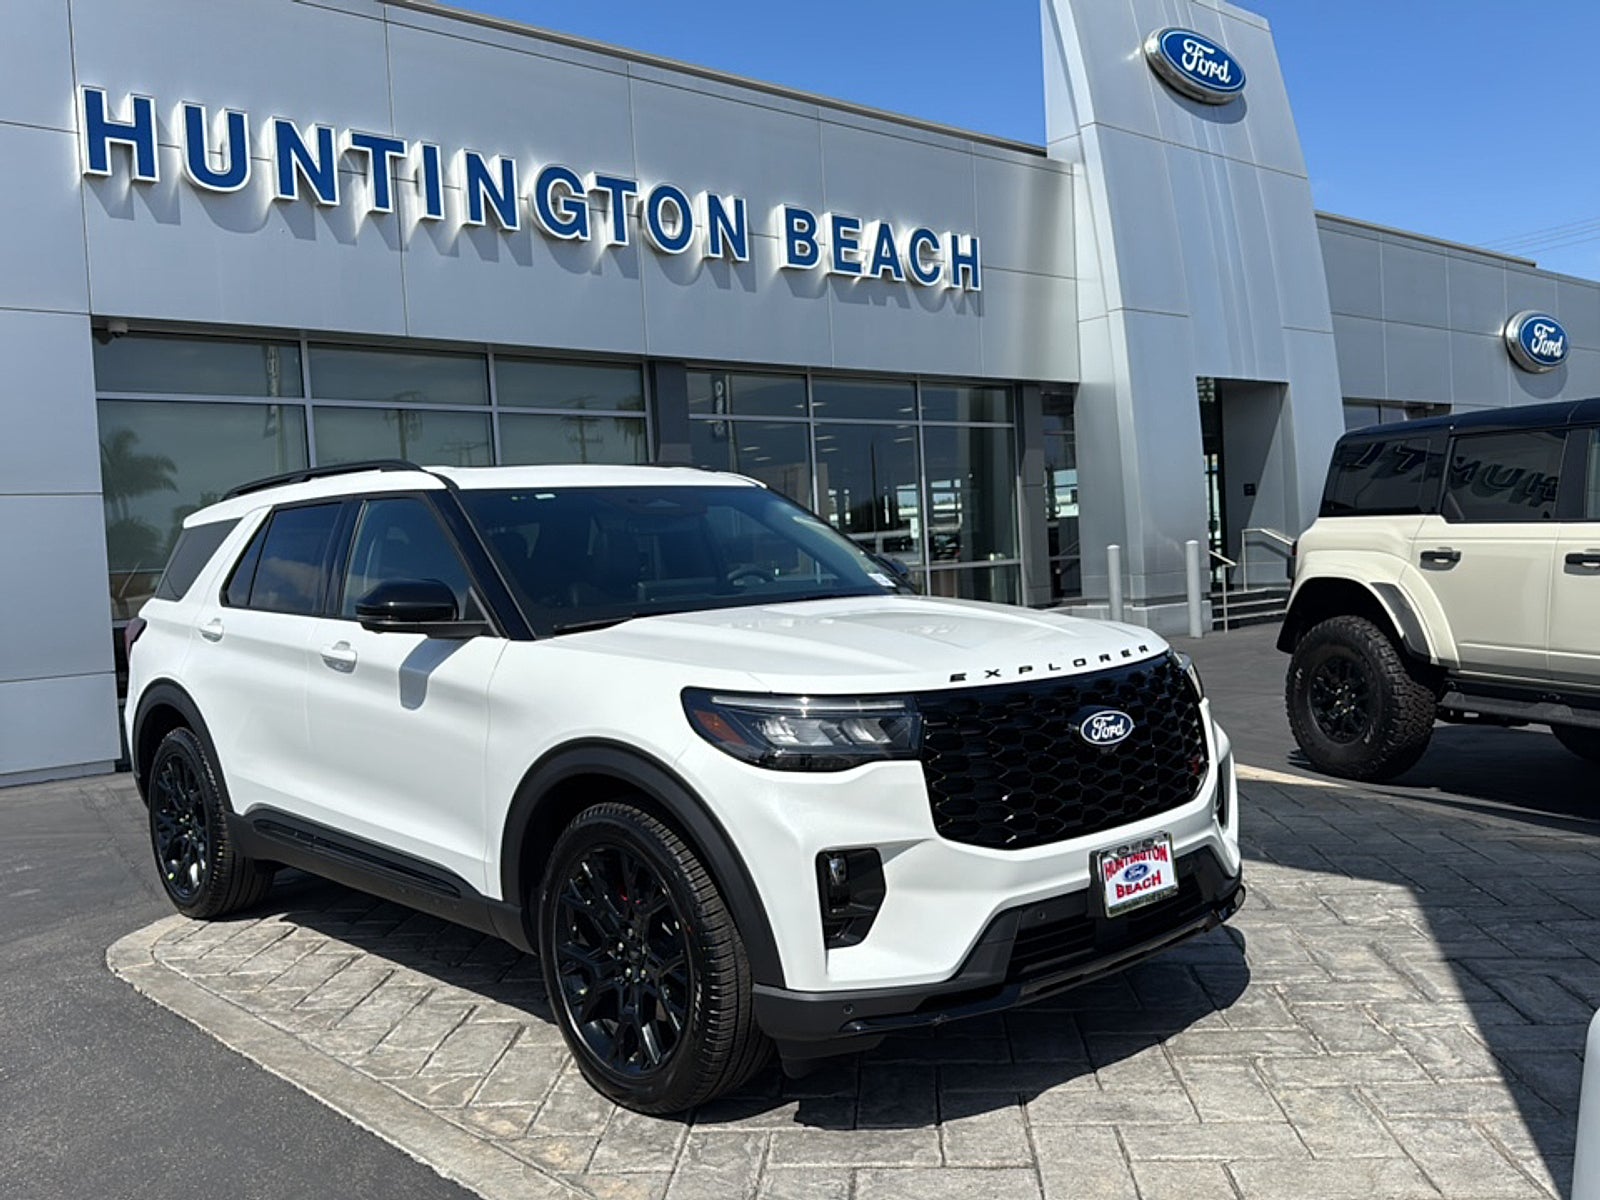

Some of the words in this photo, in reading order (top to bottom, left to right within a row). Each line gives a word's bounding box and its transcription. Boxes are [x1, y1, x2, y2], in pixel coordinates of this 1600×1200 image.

[1181, 38, 1232, 84] Ford
[81, 86, 749, 262] HUNTINGTON
[781, 204, 982, 291] BEACH
[1531, 323, 1564, 358] Ford
[949, 644, 1150, 683] EXPLORER
[1091, 714, 1126, 741] Ford
[1103, 843, 1168, 882] HUNTINGTON
[1115, 869, 1162, 899] BEACH
